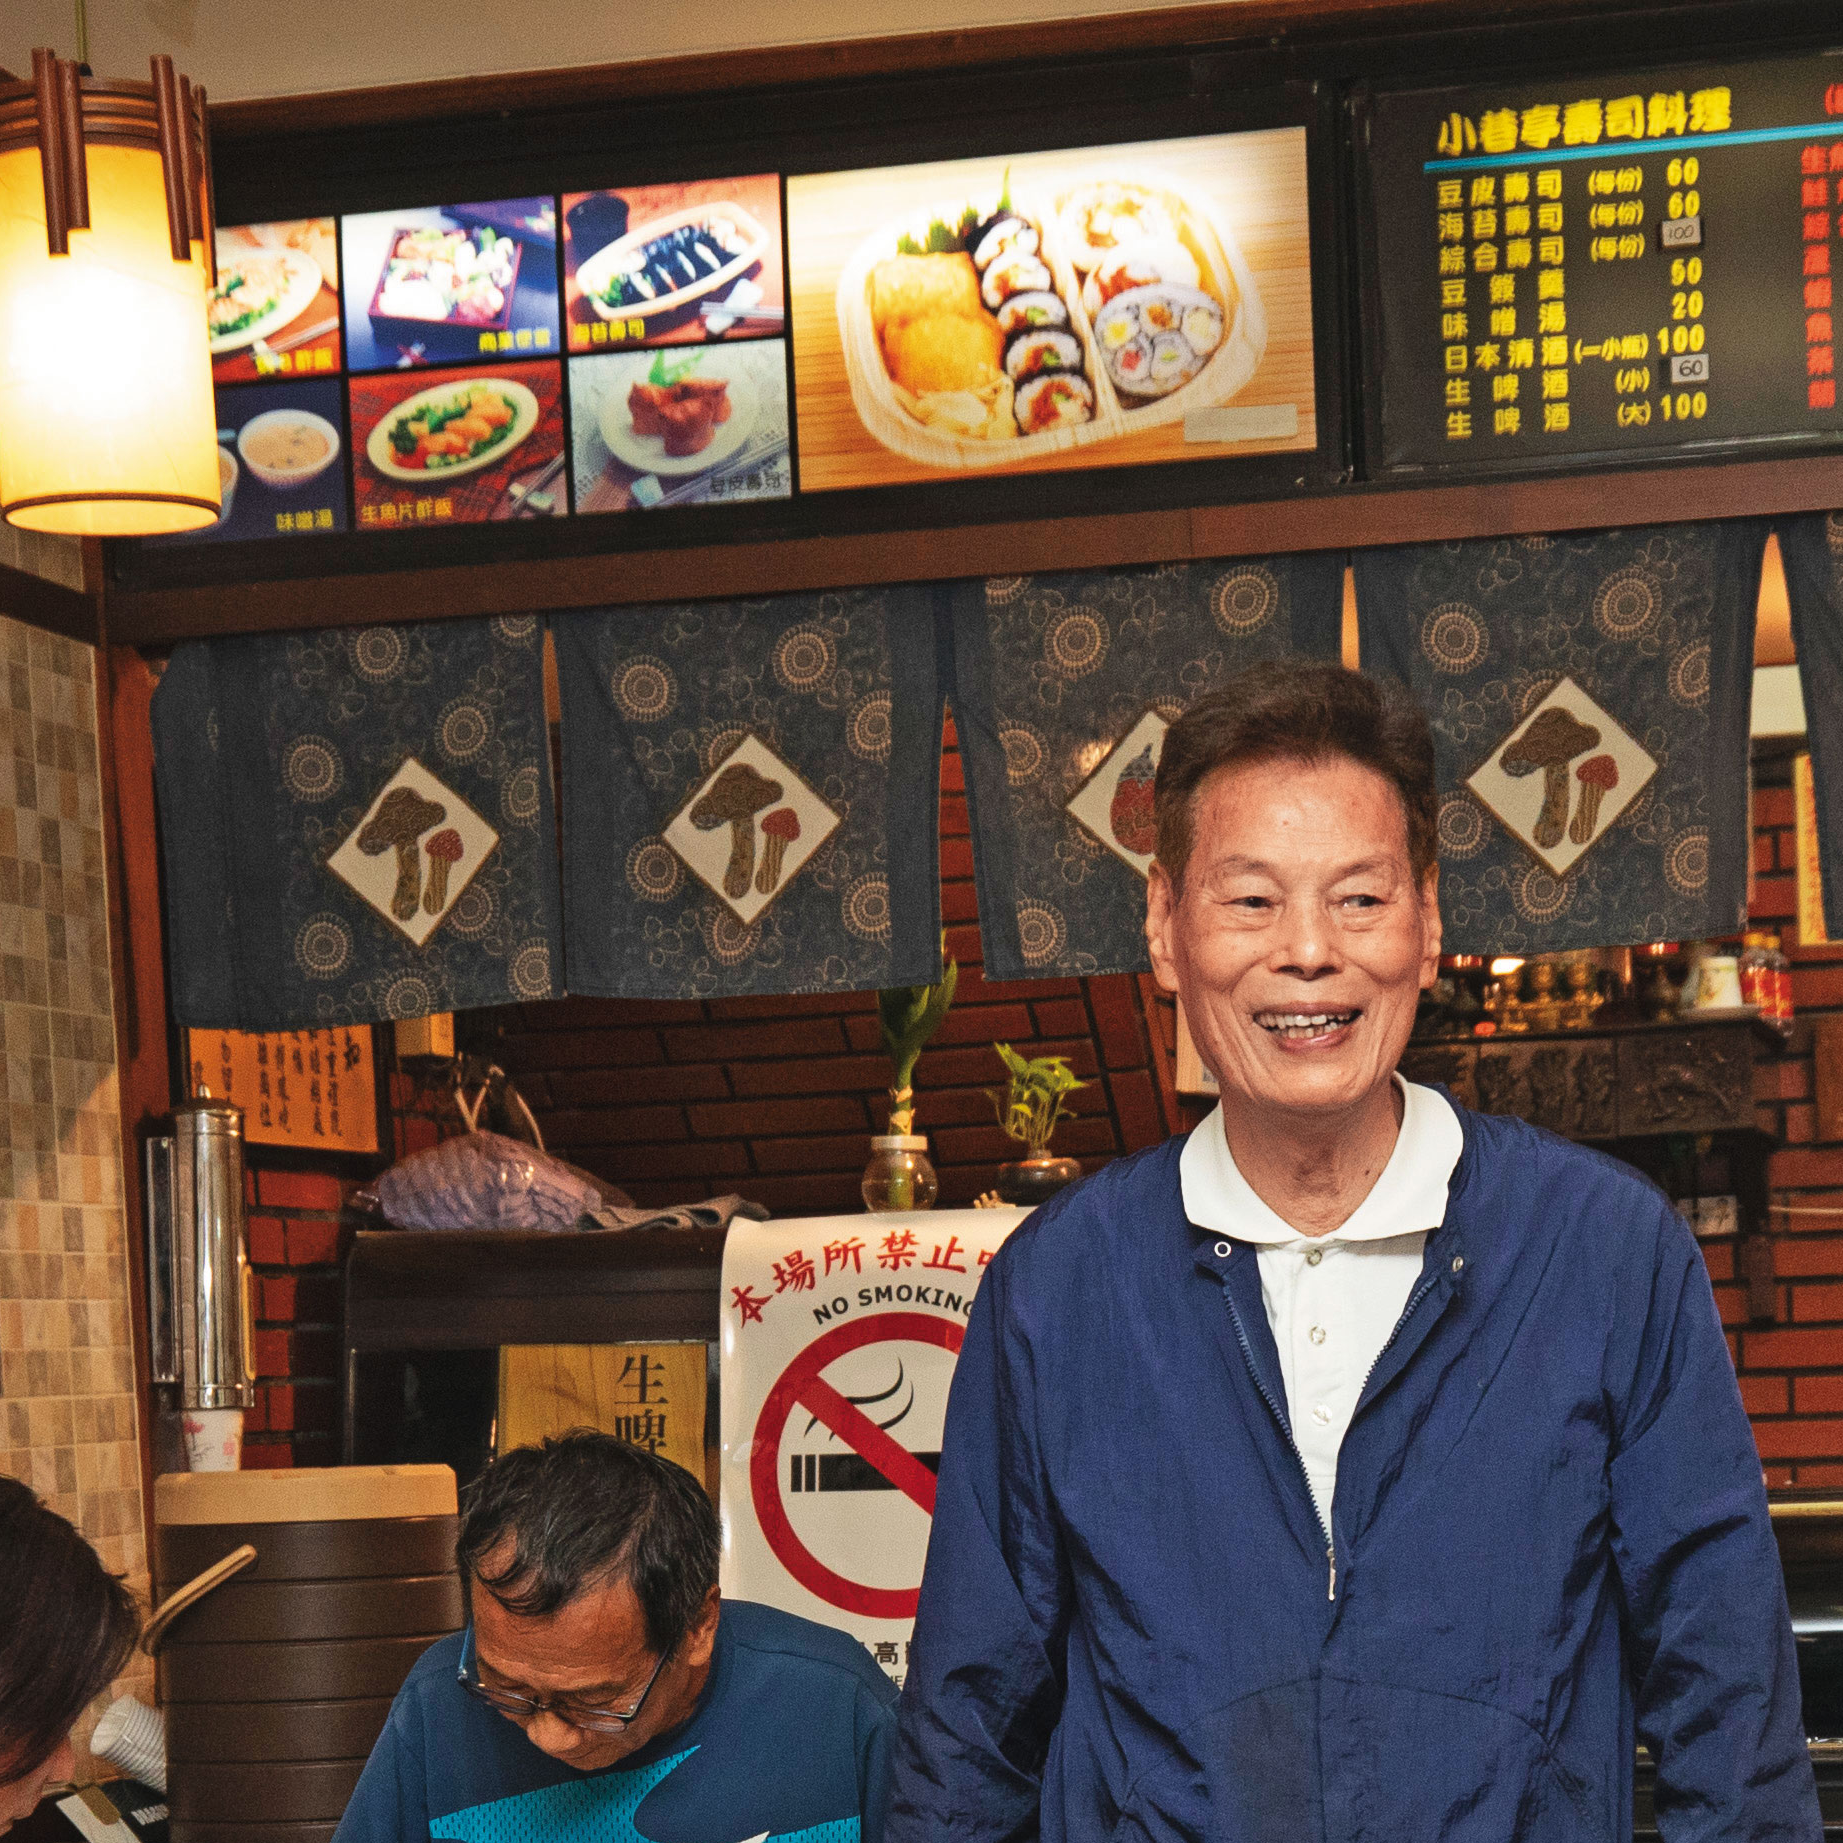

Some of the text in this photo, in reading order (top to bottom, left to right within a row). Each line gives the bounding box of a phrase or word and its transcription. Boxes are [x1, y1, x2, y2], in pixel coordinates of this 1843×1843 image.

[1437, 168, 1563, 209] 豆皮壽司
[1666, 156, 1700, 187] 60
[1438, 202, 1564, 243] 海苔壽司
[1667, 189, 1701, 219] 60
[1439, 235, 1565, 277] 綜合壽司
[1667, 225, 1695, 240] 100
[1442, 289, 1704, 340] 味噌湯 20
[1444, 334, 1569, 374] 日本清酒
[1658, 323, 1705, 355] 100
[1444, 368, 1570, 408] 生啤酒
[1678, 358, 1704, 377] 60
[1446, 390, 1708, 441] 生啤酒 (大) 100
[731, 1228, 995, 1329] 本場所禁止
[812, 1295, 851, 1327] NO
